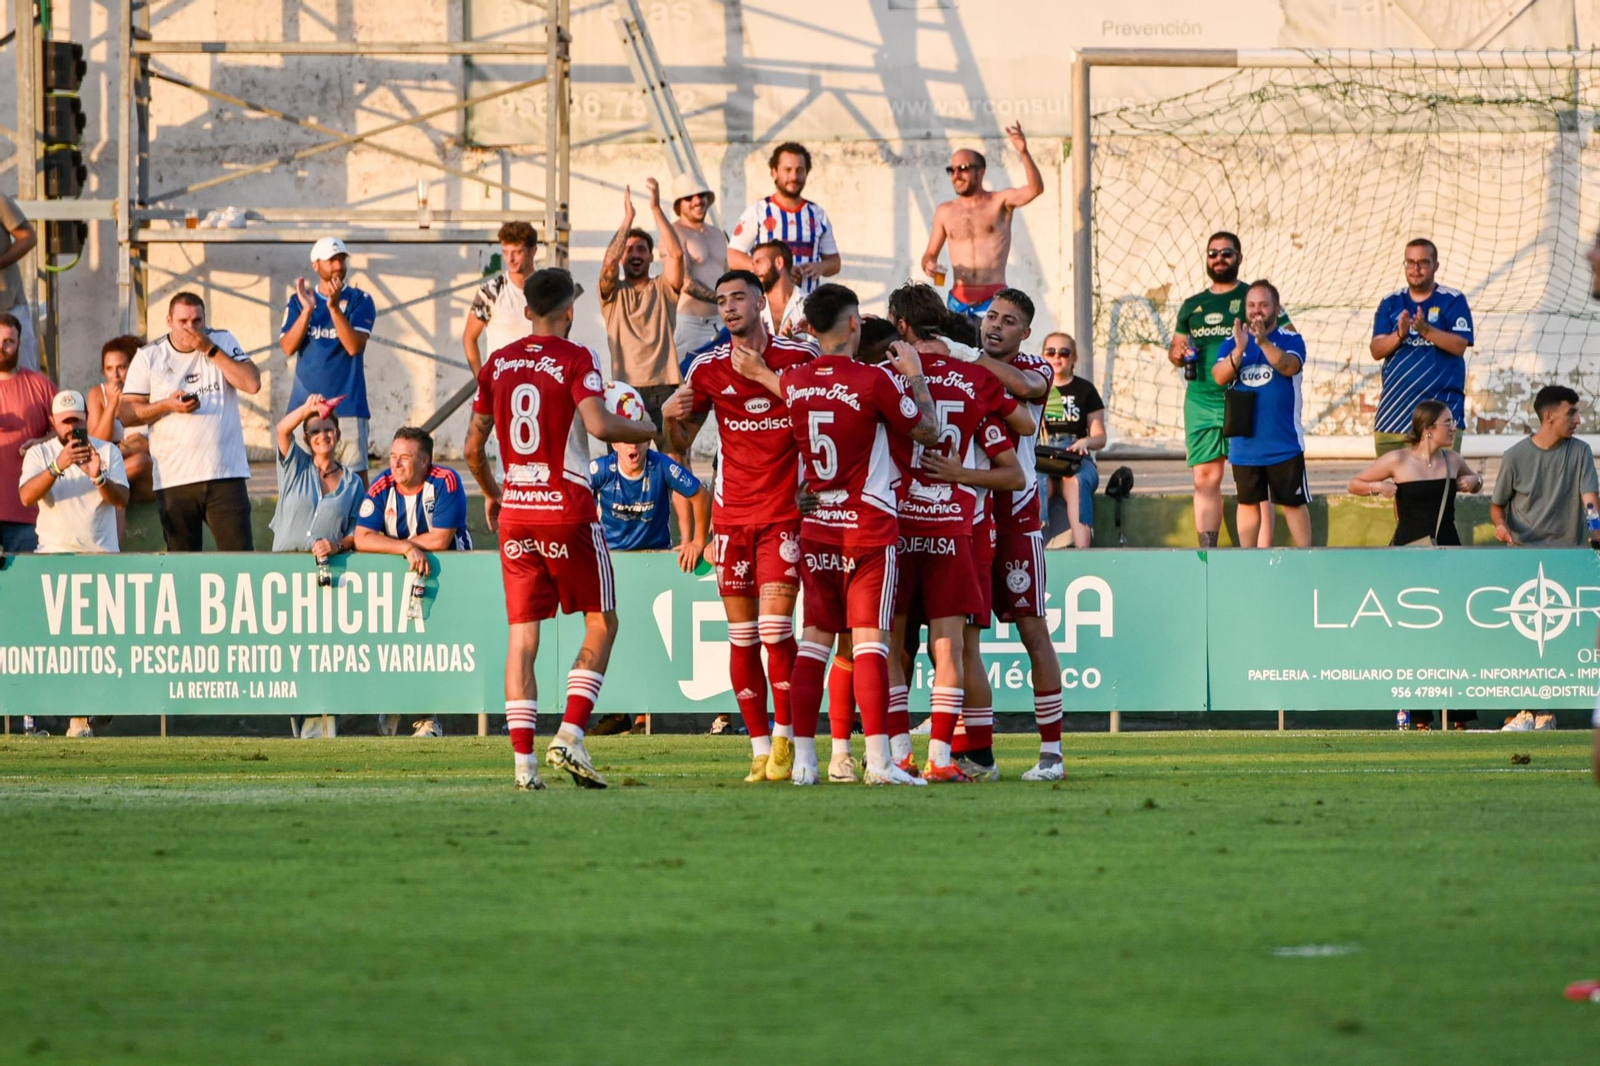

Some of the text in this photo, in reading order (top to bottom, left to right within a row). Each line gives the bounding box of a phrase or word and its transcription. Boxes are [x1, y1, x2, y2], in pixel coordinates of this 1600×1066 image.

[1102, 19, 1202, 36] Prevención
[1242, 371, 1271, 381] LUGO
[746, 402, 769, 410] LUGO
[510, 383, 540, 455] 8
[808, 411, 838, 480] 5
[714, 533, 729, 563] 17
[907, 537, 956, 556] JEALSA
[41, 572, 426, 635] VENTA BACHICHA
[1313, 586, 1444, 629] LAS
[131, 645, 219, 674] PESCADO
[227, 645, 282, 673] FRITO
[291, 644, 302, 672] Y
[308, 644, 370, 673] TAPAS
[377, 643, 475, 672] VARIADAS
[1248, 669, 1310, 681] PAPELERIA
[1320, 669, 1393, 681] MOBILIARIO
[1396, 669, 1414, 681] DE
[1416, 668, 1469, 681] OFICINA
[1480, 668, 1567, 680] INFORMATICA
[1577, 667, 1600, 679] IMP
[169, 681, 185, 699] LA
[188, 681, 240, 699] REYERTA
[250, 681, 265, 698] LA
[268, 681, 298, 698] JARA
[1391, 687, 1412, 698] 956
[1414, 687, 1453, 698] 478941
